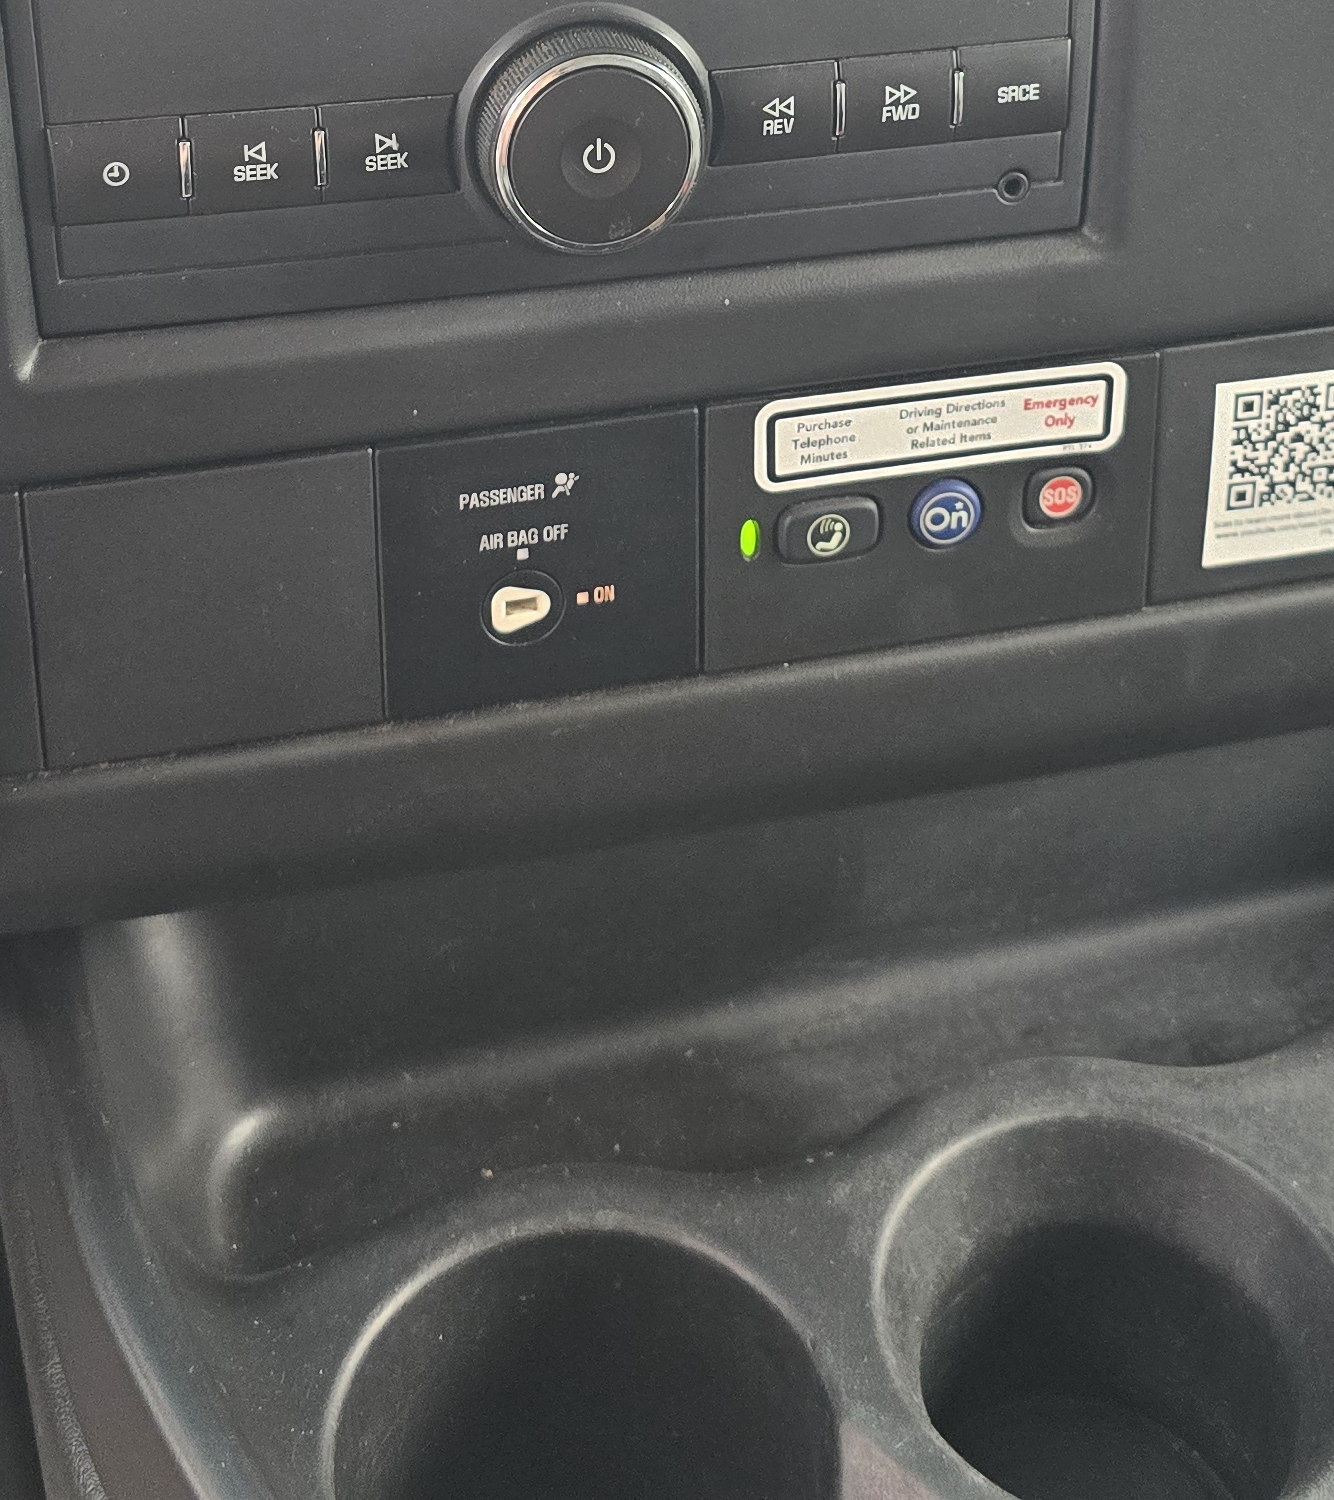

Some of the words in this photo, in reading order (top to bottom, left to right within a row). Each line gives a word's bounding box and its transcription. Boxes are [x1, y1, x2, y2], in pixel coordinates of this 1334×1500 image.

[997, 83, 1040, 104] SRCE
[881, 103, 920, 123] FWD
[762, 117, 795, 136] REV
[365, 151, 409, 172] SEEK
[233, 162, 279, 182] SEEK
[899, 405, 942, 420] Driving
[946, 399, 1006, 415] Directions
[1023, 395, 1099, 411] Emergency
[796, 418, 853, 434] Purchase
[906, 425, 919, 434] or
[922, 415, 998, 433] Maintenance
[1044, 412, 1076, 429] Only
[791, 433, 857, 450] Telephone
[911, 434, 956, 450] Related
[960, 431, 992, 444] Items
[800, 450, 849, 466] Minutes
[459, 483, 545, 510] PASSENGER
[1042, 485, 1079, 508] SOS
[479, 533, 504, 552] AIR
[507, 528, 539, 548] BAG
[543, 523, 569, 542] OFF
[593, 584, 615, 605] ON
